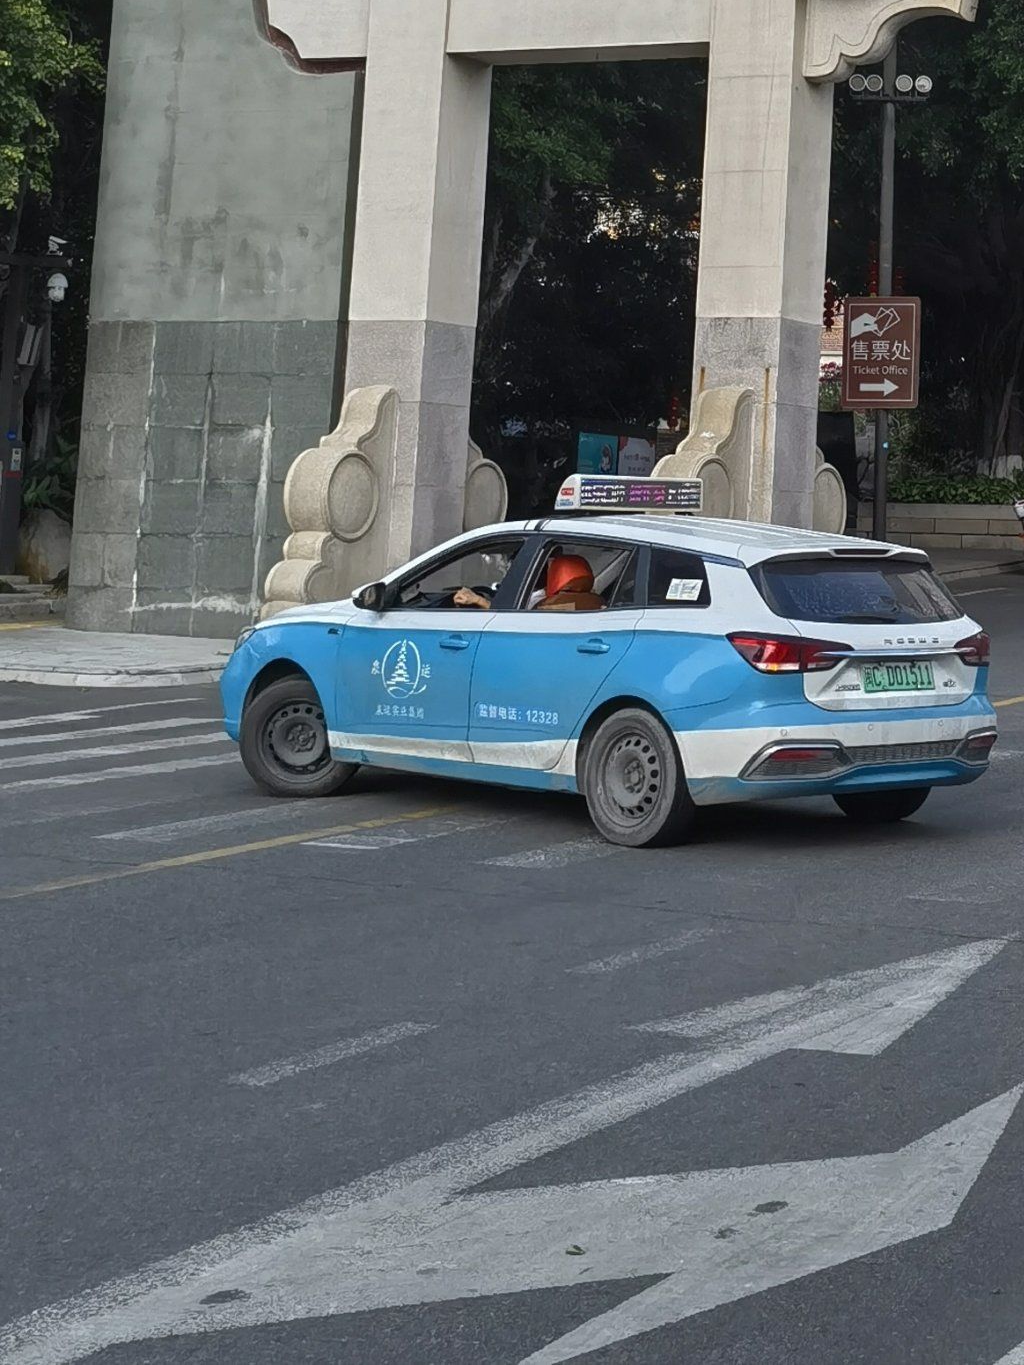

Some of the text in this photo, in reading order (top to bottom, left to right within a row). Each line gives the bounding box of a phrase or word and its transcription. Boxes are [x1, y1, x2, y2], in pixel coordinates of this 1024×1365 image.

[850, 339, 911, 361] 售票处
[852, 364, 909, 375] Ticket Office
